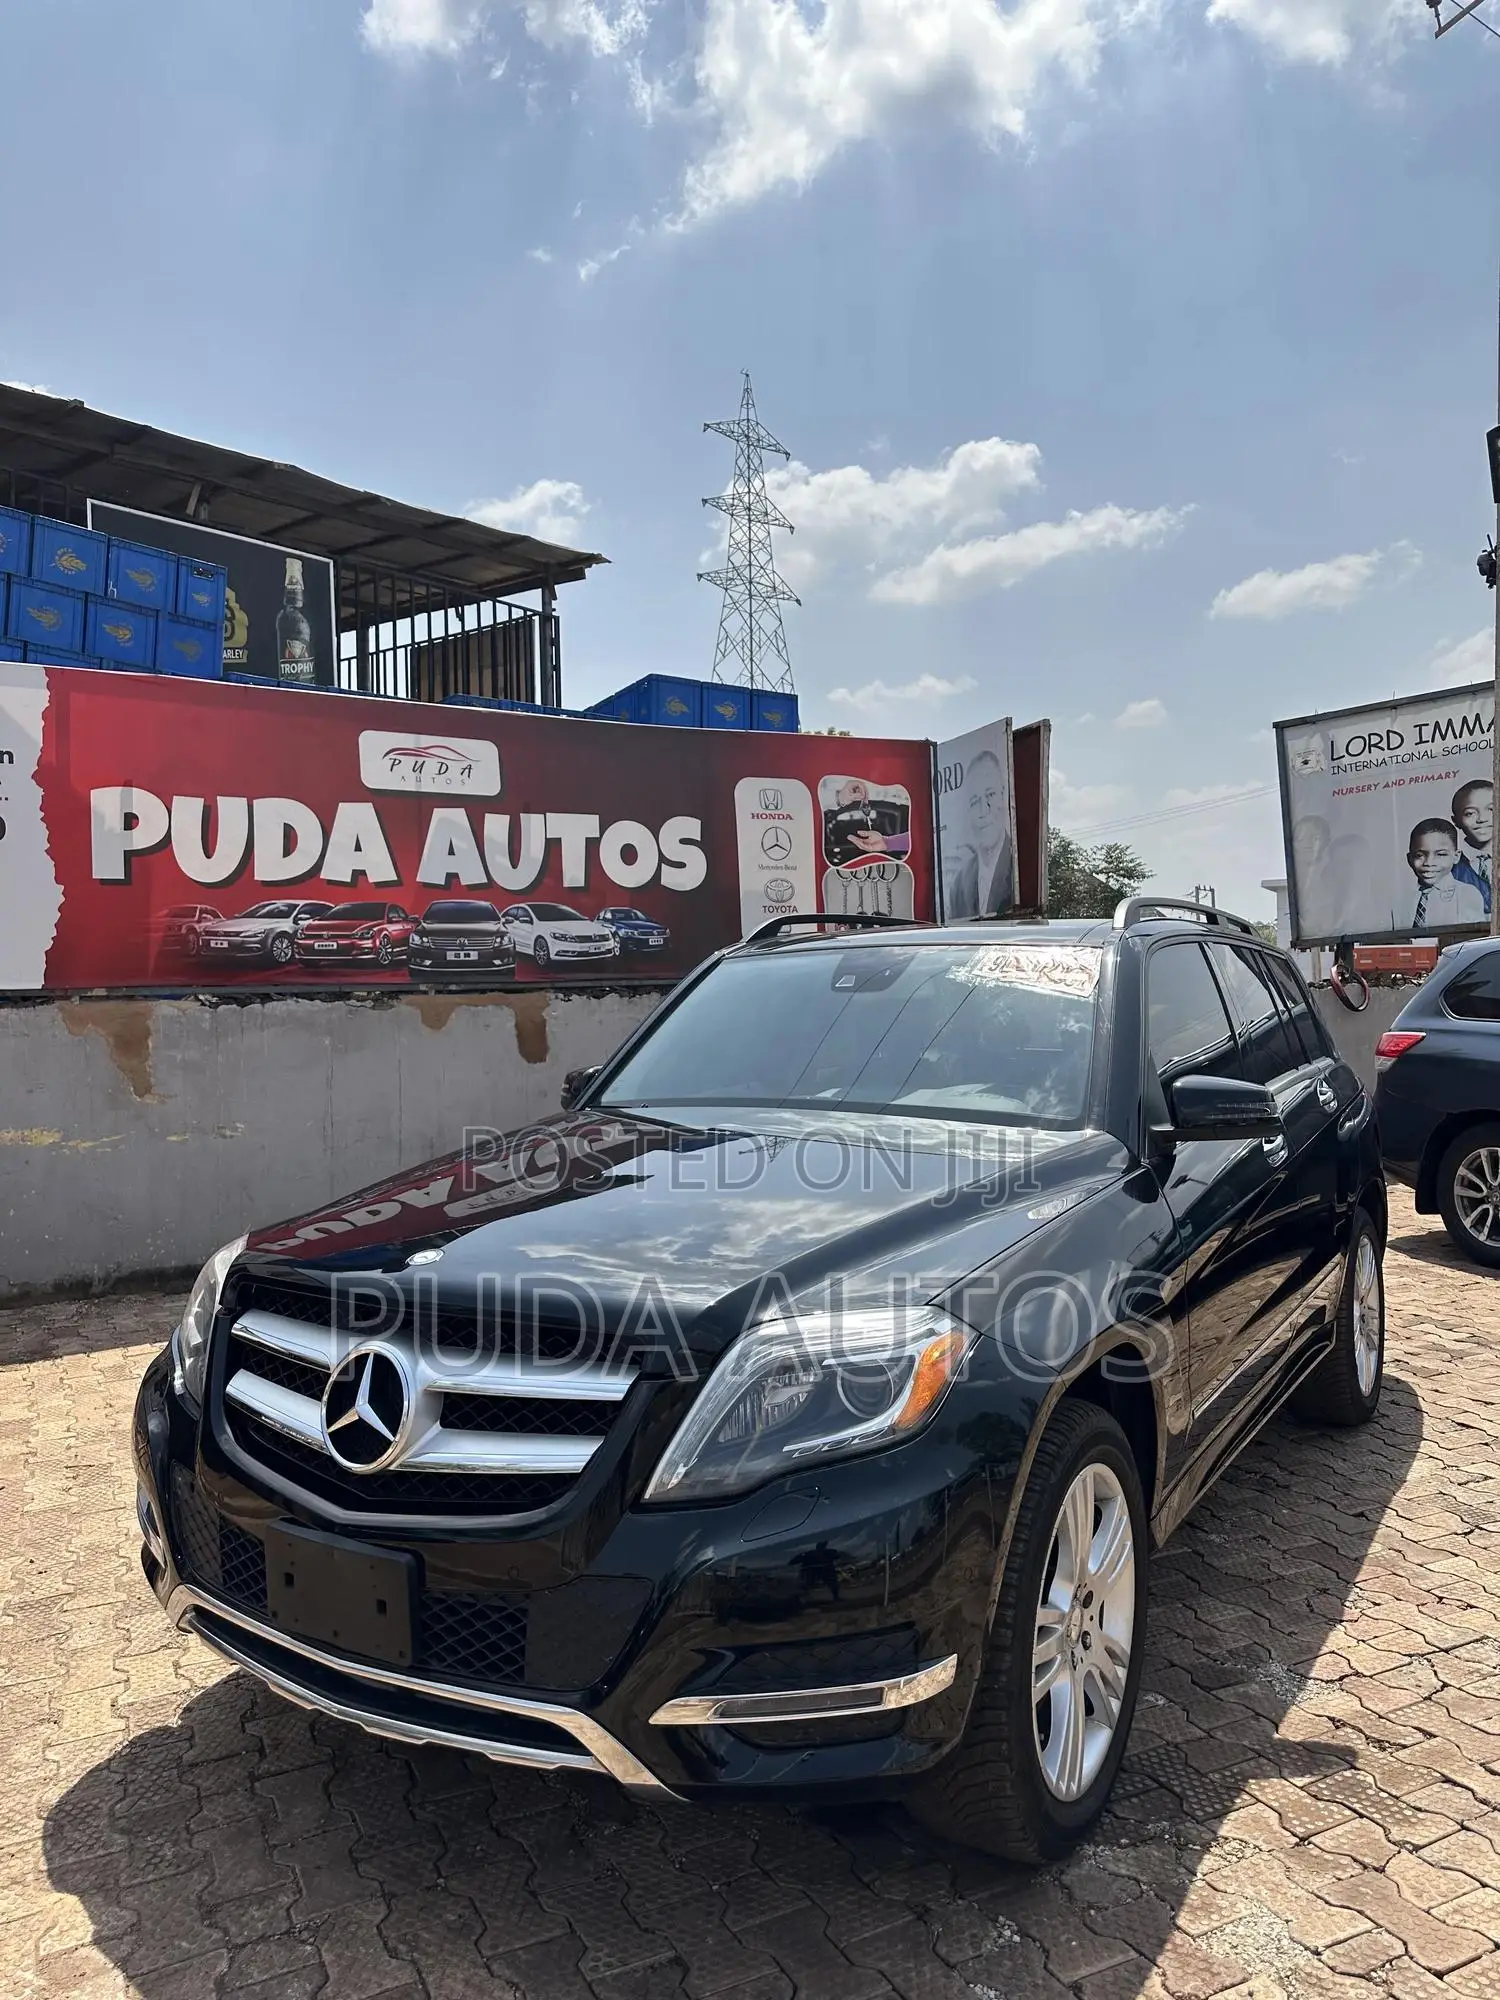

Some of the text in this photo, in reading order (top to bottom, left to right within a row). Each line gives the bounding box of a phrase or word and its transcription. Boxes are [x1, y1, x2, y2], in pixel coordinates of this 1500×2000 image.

[280, 661, 315, 674] TROPHY
[1330, 729, 1405, 762] LORD
[389, 758, 473, 779] PUDA
[1331, 748, 1437, 776] INTERNATIONAL
[400, 776, 466, 786] AUTOS
[1332, 770, 1460, 797] NURSERY AND PRIMARY
[750, 812, 794, 821] HONDA
[90, 786, 708, 892] PUDA AUTOS
[762, 905, 799, 914] TOYOTA
